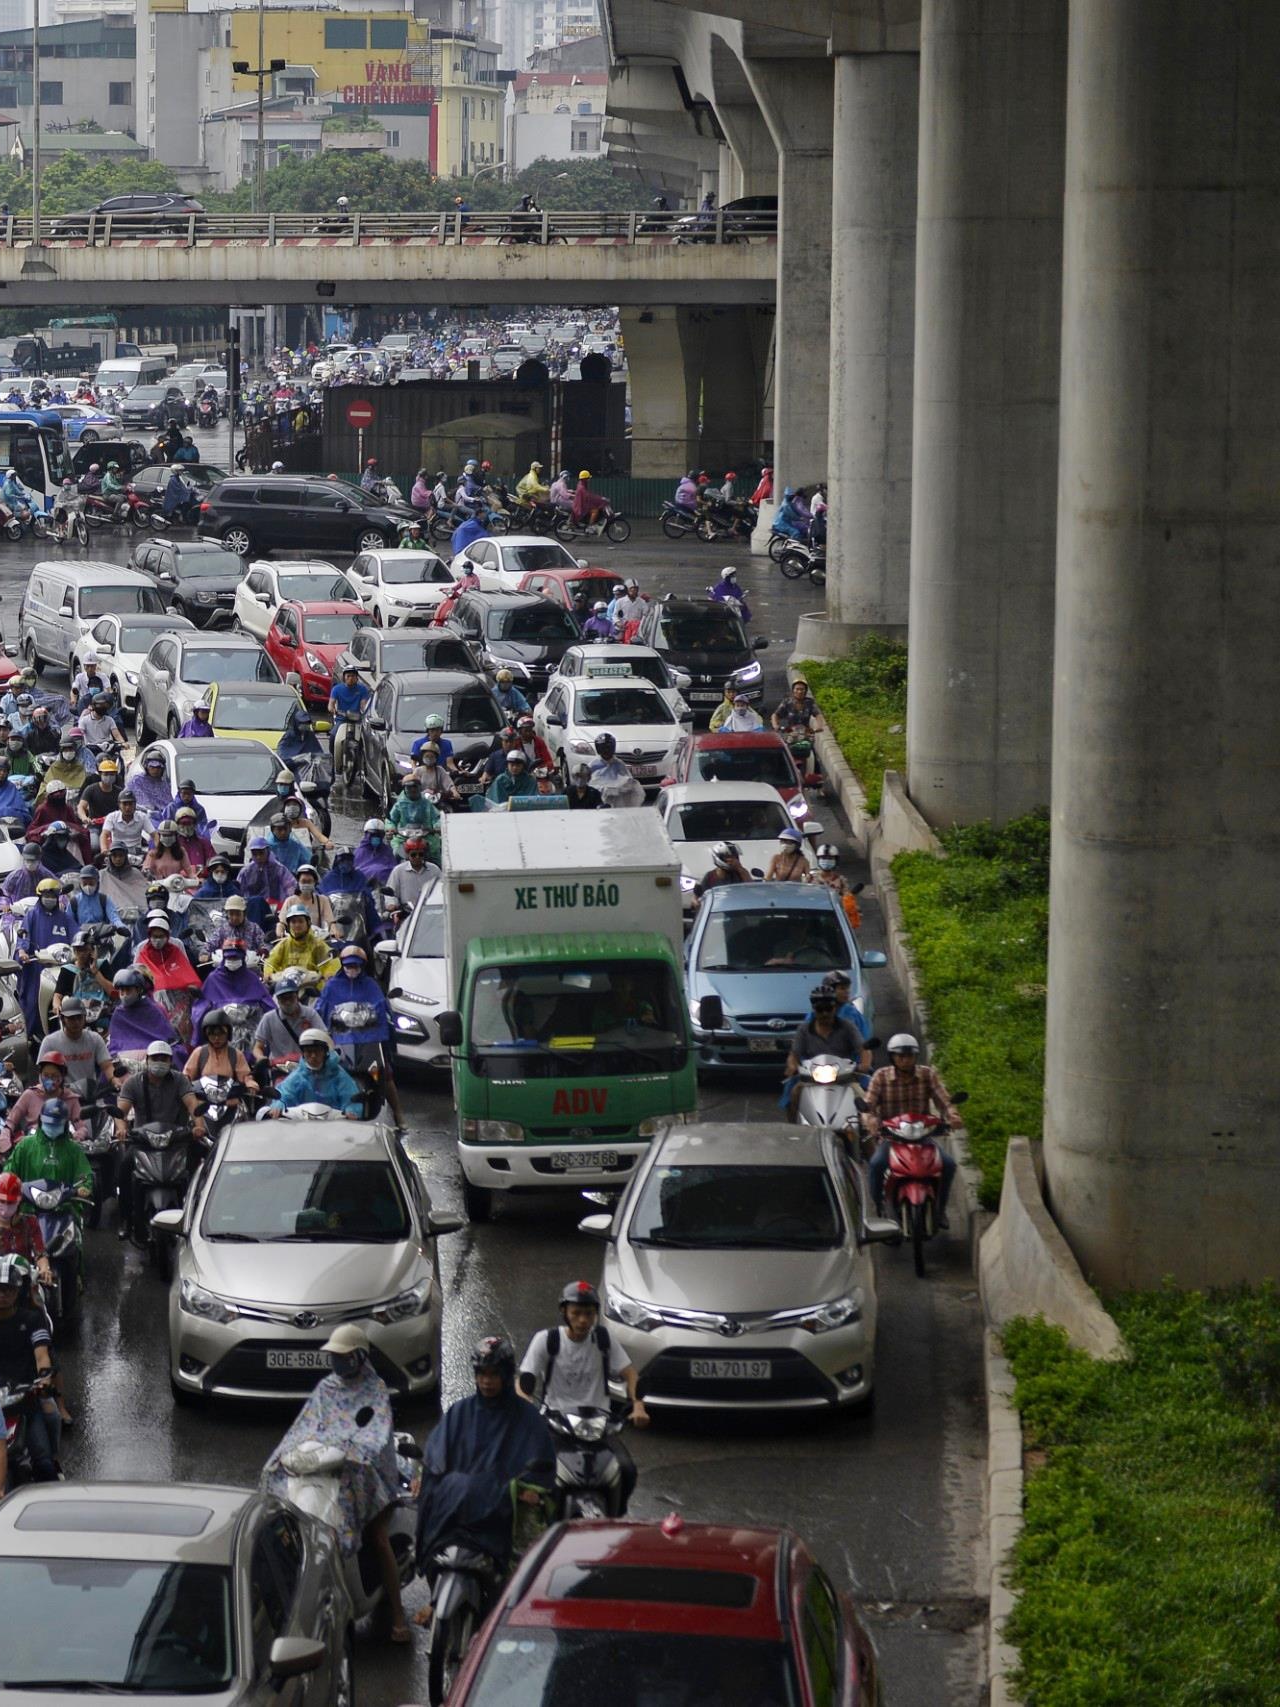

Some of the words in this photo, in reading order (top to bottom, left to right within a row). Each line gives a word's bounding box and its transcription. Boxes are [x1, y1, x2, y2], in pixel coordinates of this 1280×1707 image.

[515, 886, 538, 910] XE
[542, 883, 579, 908] THƯ
[583, 879, 619, 907] BÁO
[552, 1088, 608, 1116] ADV
